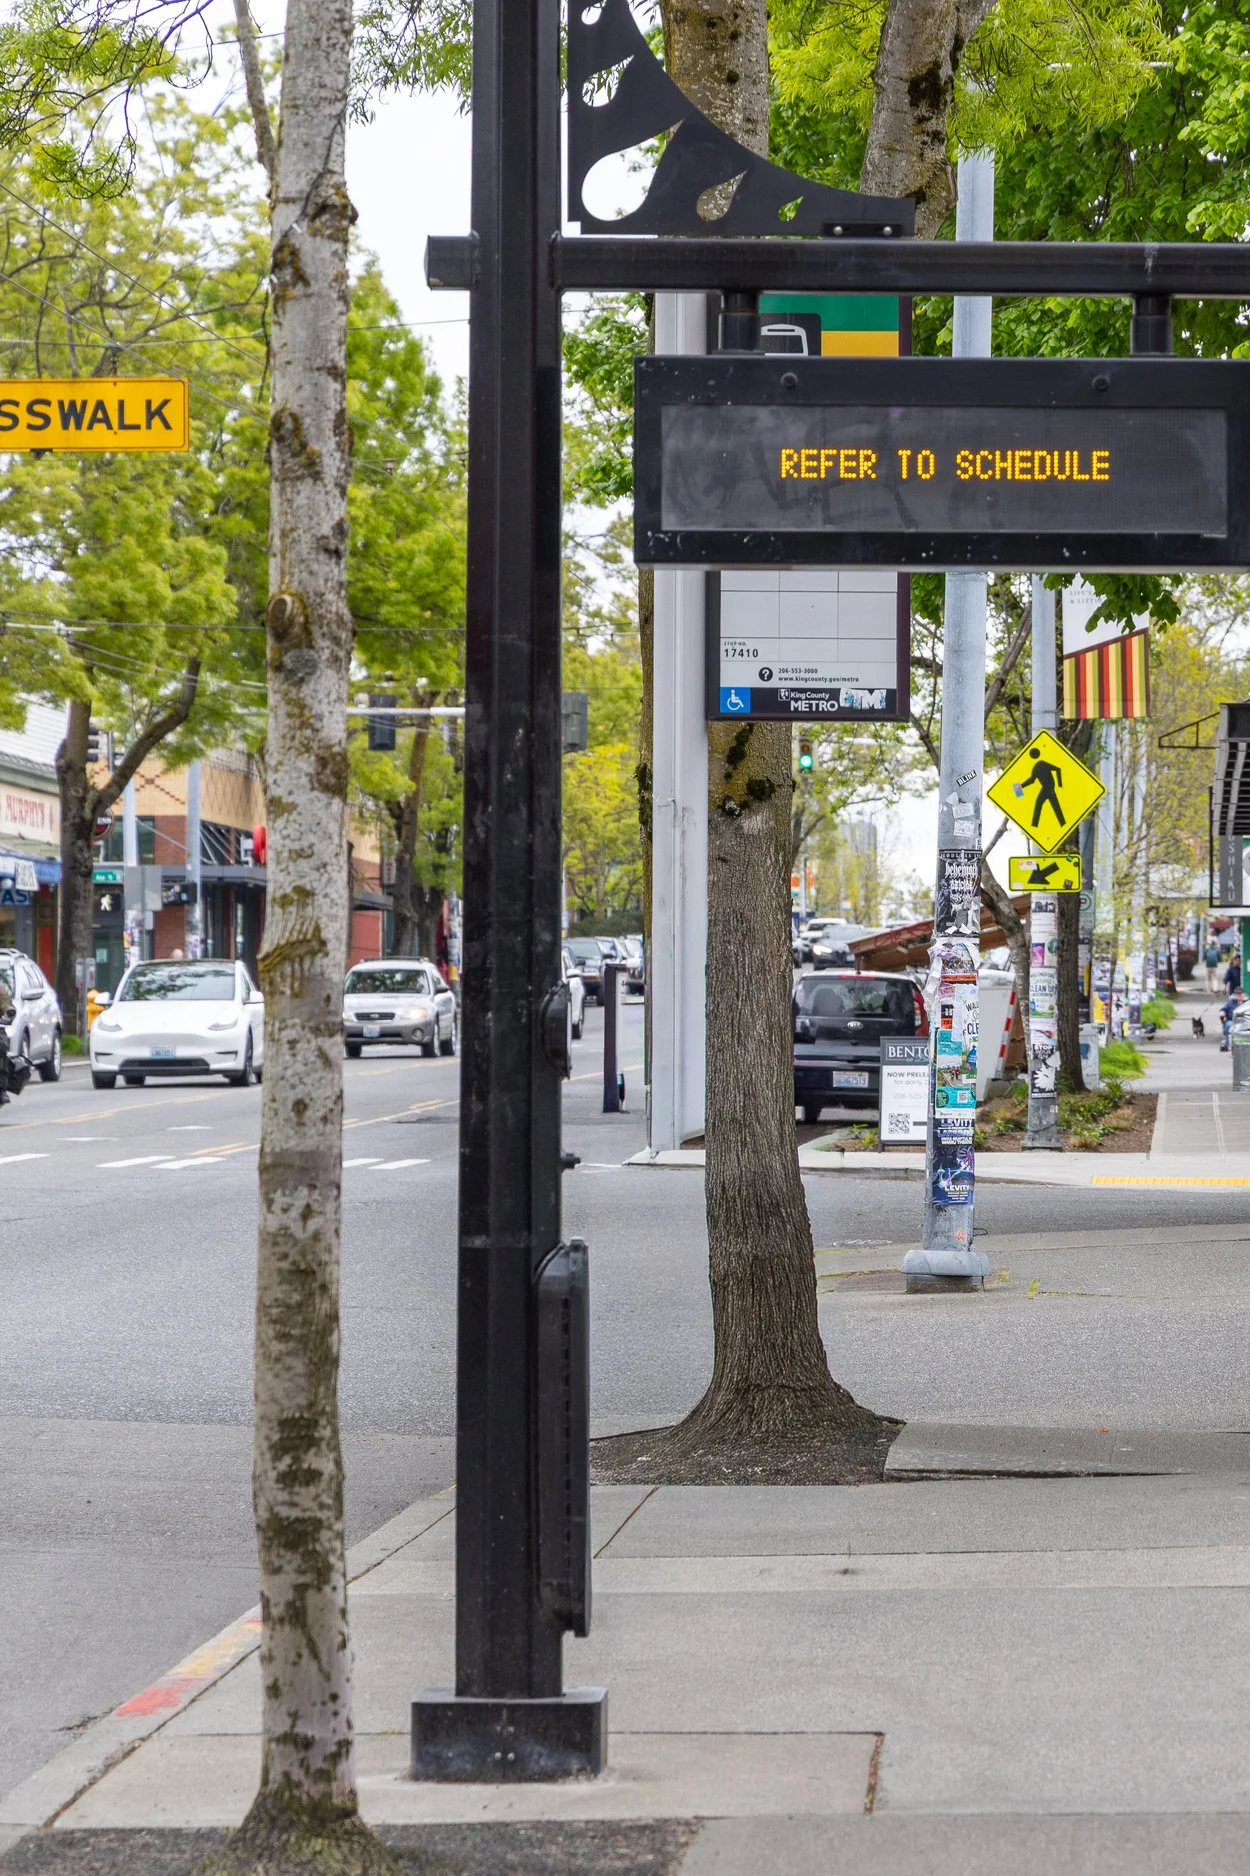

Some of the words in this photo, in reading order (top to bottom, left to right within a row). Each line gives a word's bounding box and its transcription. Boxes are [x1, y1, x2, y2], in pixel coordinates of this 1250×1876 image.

[781, 449, 877, 479] REFER
[898, 449, 935, 479] TO
[956, 450, 1110, 480] SCHEDULE
[724, 648, 759, 658] 17410
[778, 675, 859, 683] www.kingcounty.gov/metro
[790, 691, 806, 700] King
[806, 691, 830, 700] County
[790, 700, 838, 712] METRO
[957, 770, 977, 786] BLINK
